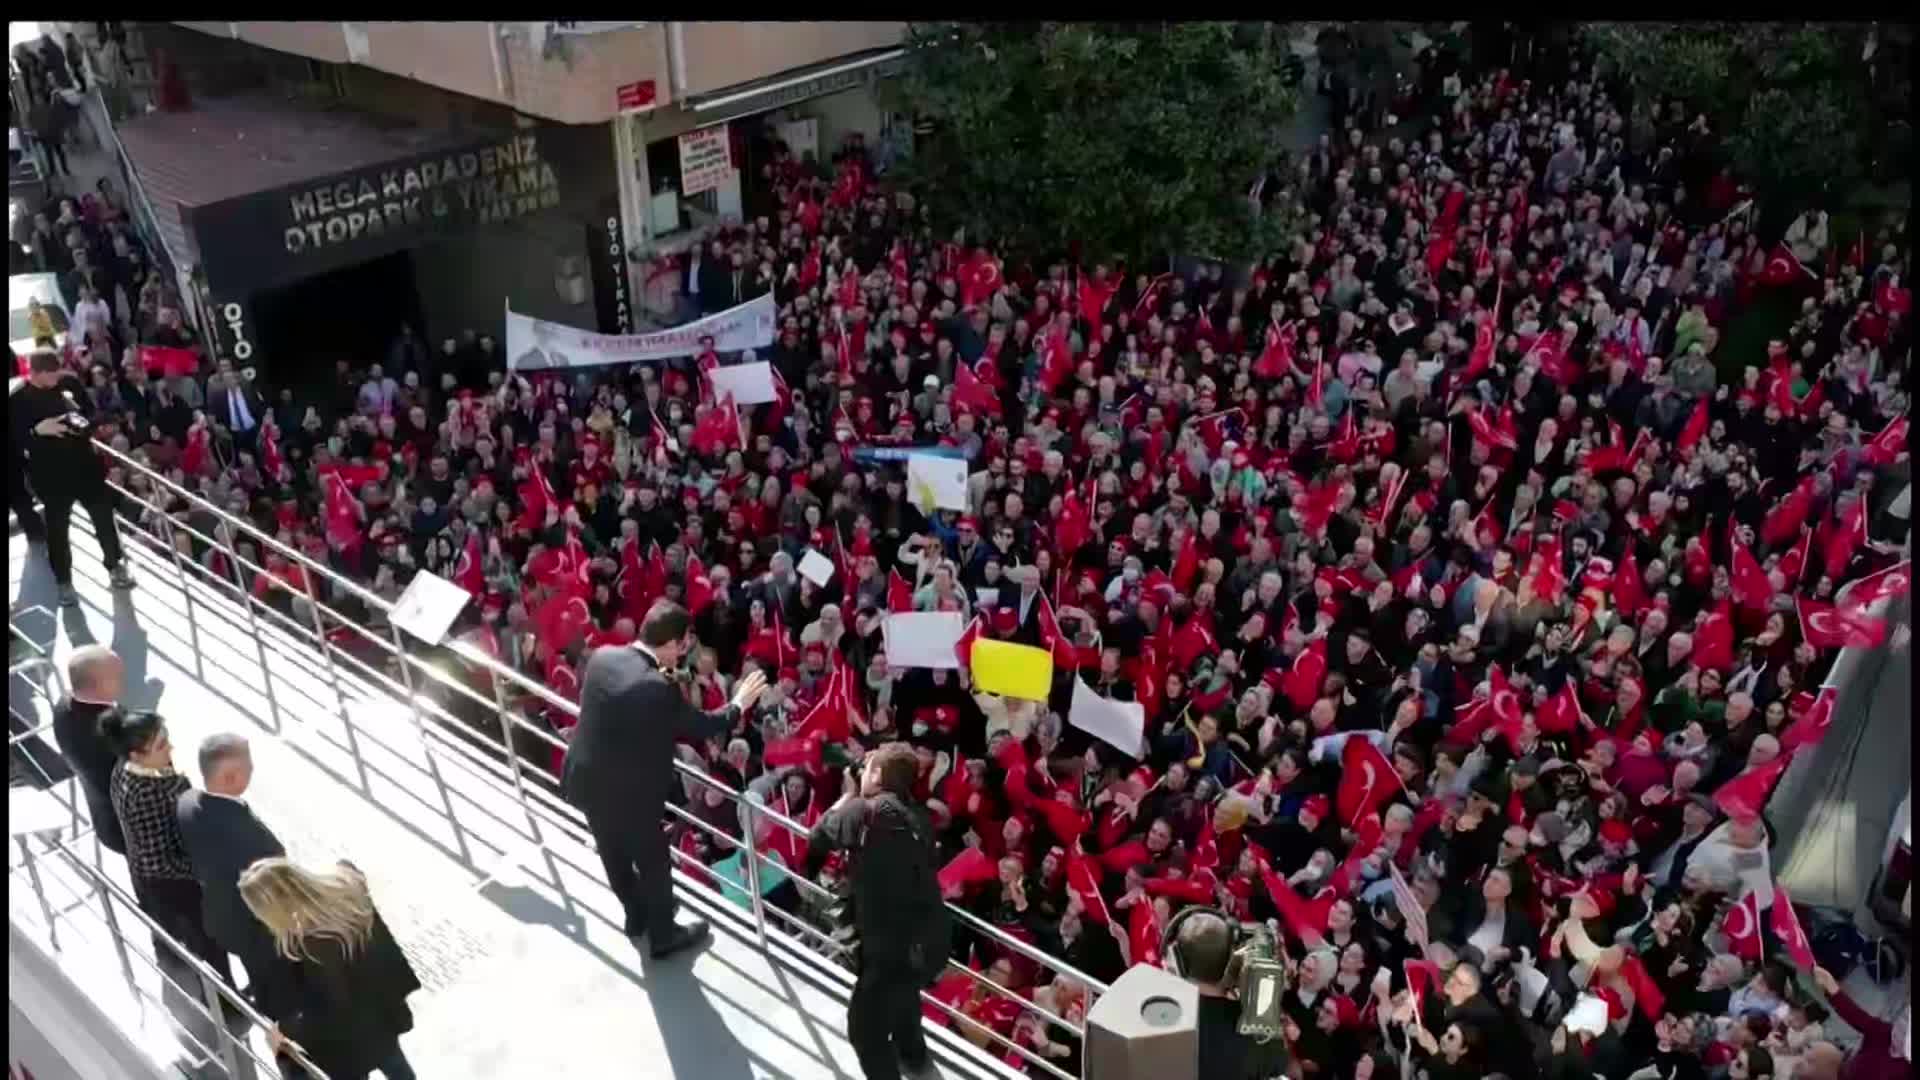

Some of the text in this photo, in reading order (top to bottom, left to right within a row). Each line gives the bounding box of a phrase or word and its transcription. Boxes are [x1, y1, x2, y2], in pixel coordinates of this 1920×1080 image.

[292, 177, 377, 222] MEGA
[285, 198, 419, 252] OTOPARK
[607, 217, 620, 256] OTO
